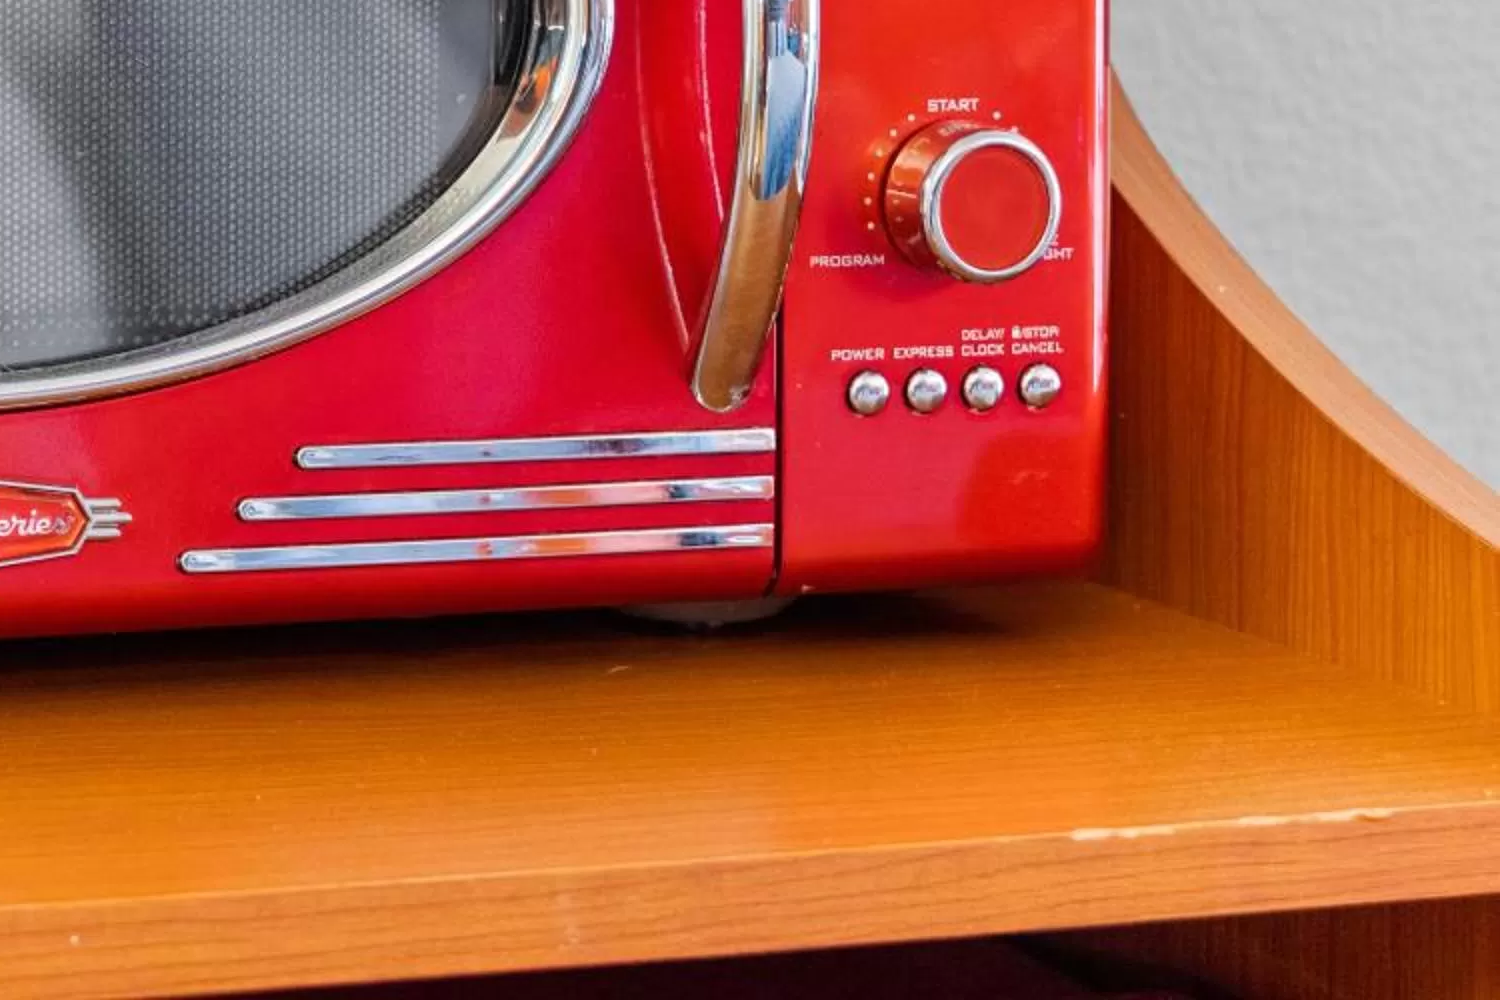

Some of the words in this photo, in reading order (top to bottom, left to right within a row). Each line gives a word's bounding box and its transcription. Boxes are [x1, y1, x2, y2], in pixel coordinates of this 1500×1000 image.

[927, 97, 980, 113] START
[809, 254, 886, 268] PROGRAM
[831, 348, 886, 361] POWER
[893, 345, 955, 360] EXPRESS
[961, 343, 1005, 357] CLOCK
[1011, 340, 1065, 355] CANCEL
